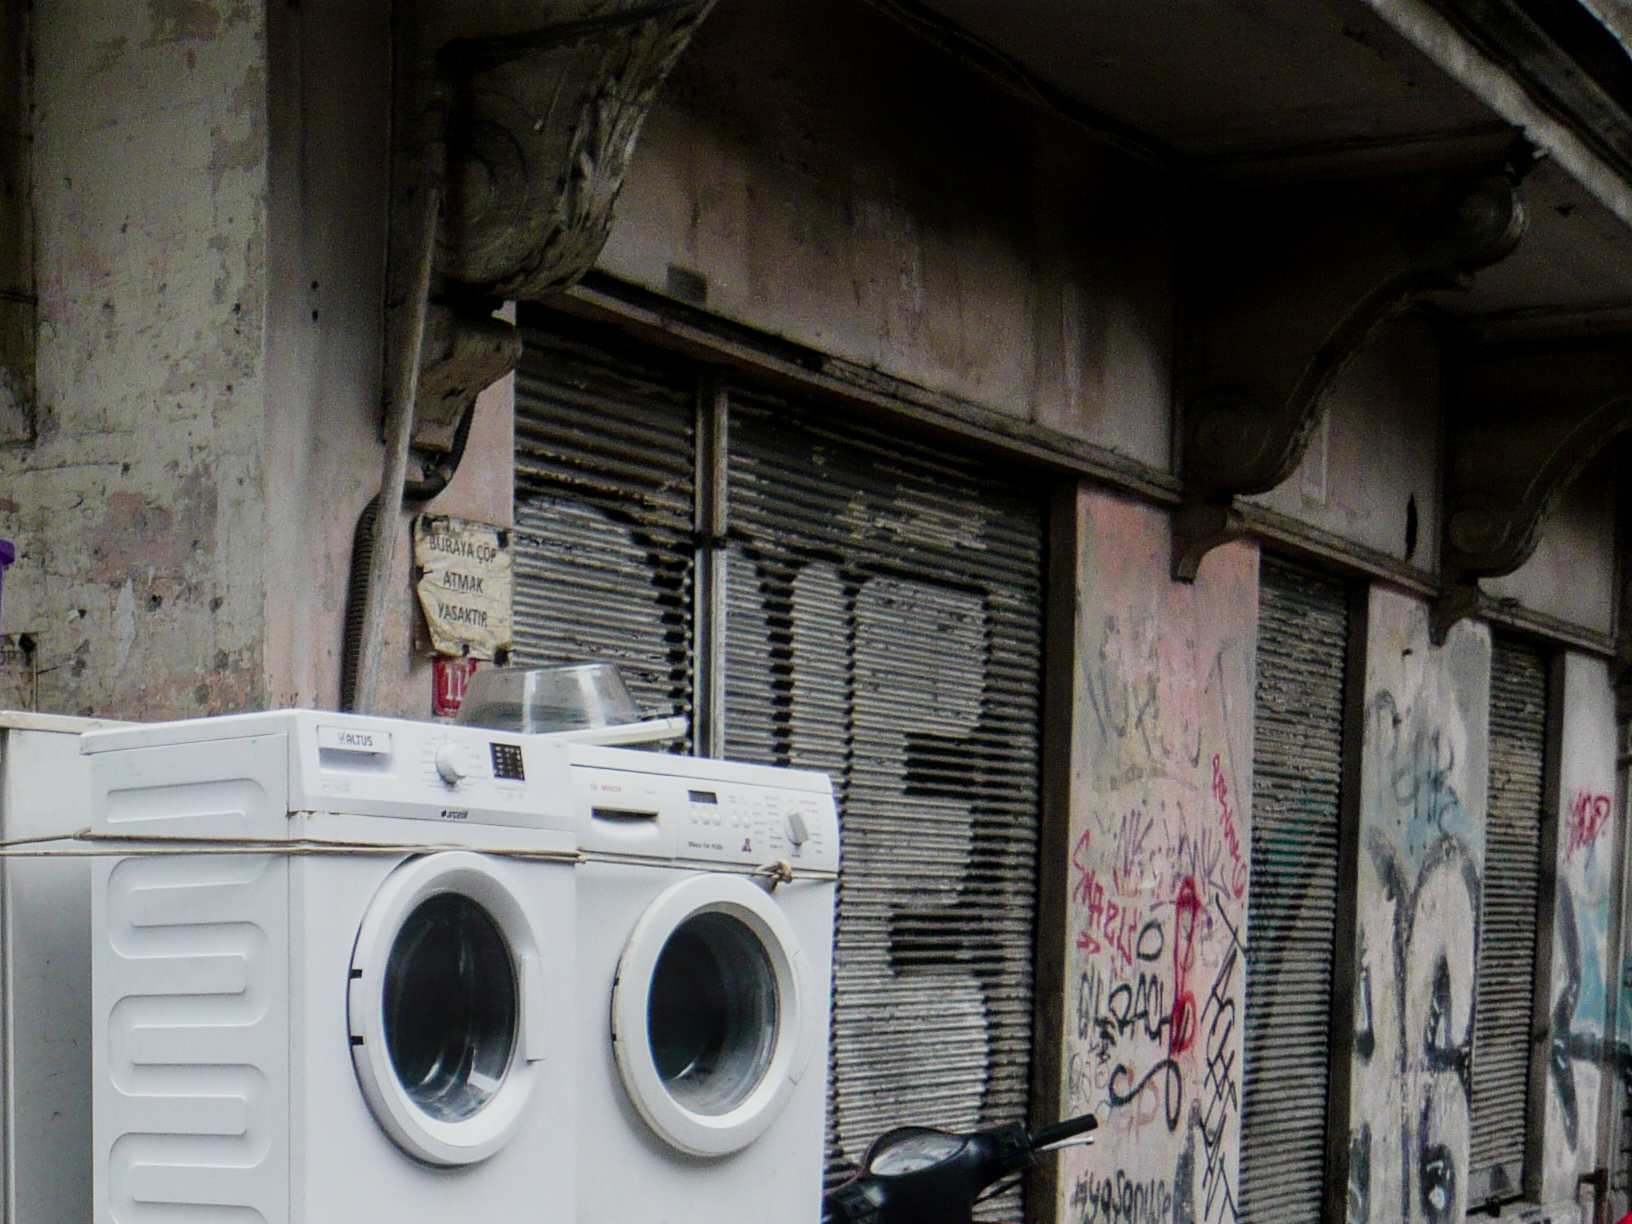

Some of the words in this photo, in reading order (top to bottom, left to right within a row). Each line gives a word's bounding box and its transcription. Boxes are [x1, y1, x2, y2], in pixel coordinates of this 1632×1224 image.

[429, 534, 474, 557] BURAYA
[476, 542, 497, 564] ÇÖP
[443, 571, 484, 594] ATMAK
[346, 734, 374, 747] ALTUS
